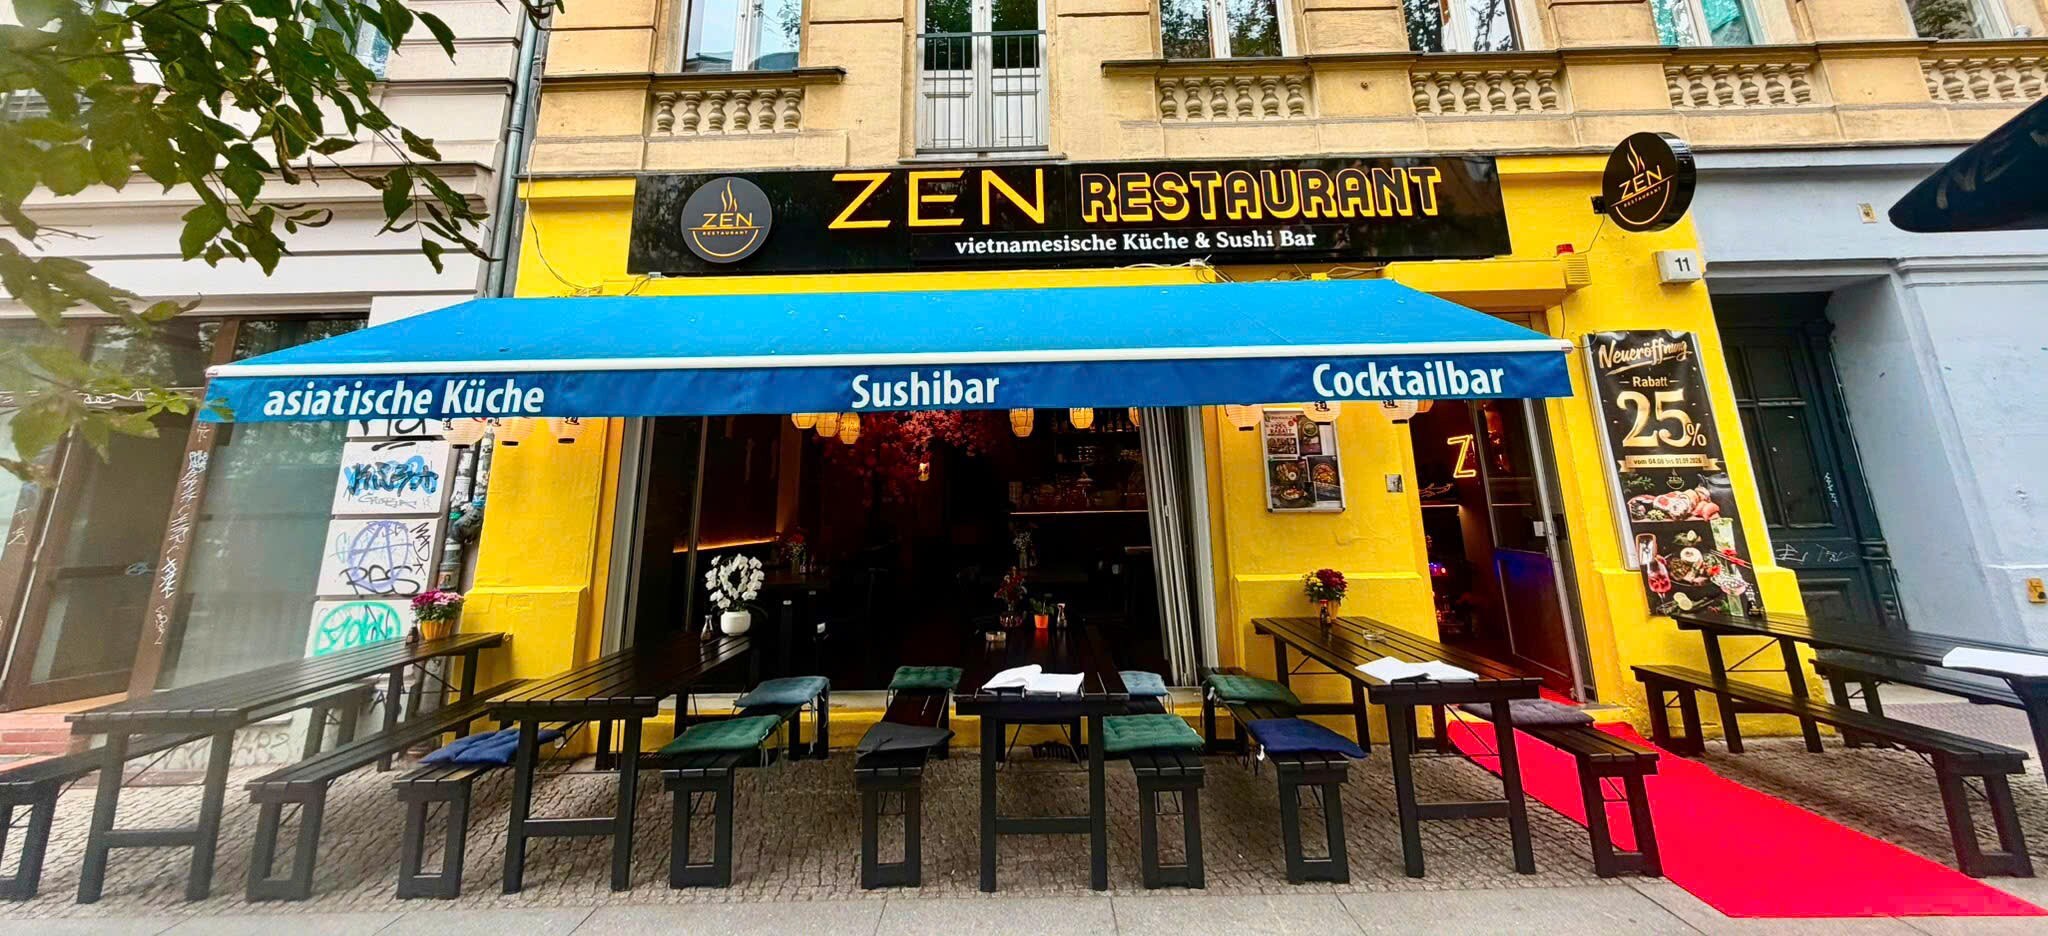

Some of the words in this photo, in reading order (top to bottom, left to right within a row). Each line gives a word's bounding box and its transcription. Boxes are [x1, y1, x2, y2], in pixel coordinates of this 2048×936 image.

[828, 168, 1045, 229] ZEN
[1080, 166, 1441, 223] RESTAURANT
[1619, 164, 1663, 200] ZEN
[1623, 186, 1662, 208] RESTAURANT
[702, 212, 753, 228] ZEN
[955, 234, 1117, 254] vietnamesische
[1123, 231, 1189, 251] Küche
[1195, 231, 1211, 249] &
[1216, 229, 1273, 248] Sushi
[1280, 230, 1317, 247] Bar
[1675, 256, 1690, 272] 11
[1598, 337, 1692, 368] Neueröffnung
[851, 369, 1000, 409] Sushibar
[1312, 360, 1504, 398] Cocktailbar
[1632, 376, 1668, 387] Rabatt
[263, 380, 432, 416] asiatische
[441, 378, 545, 414] Küche
[1616, 388, 1707, 448] 25%
